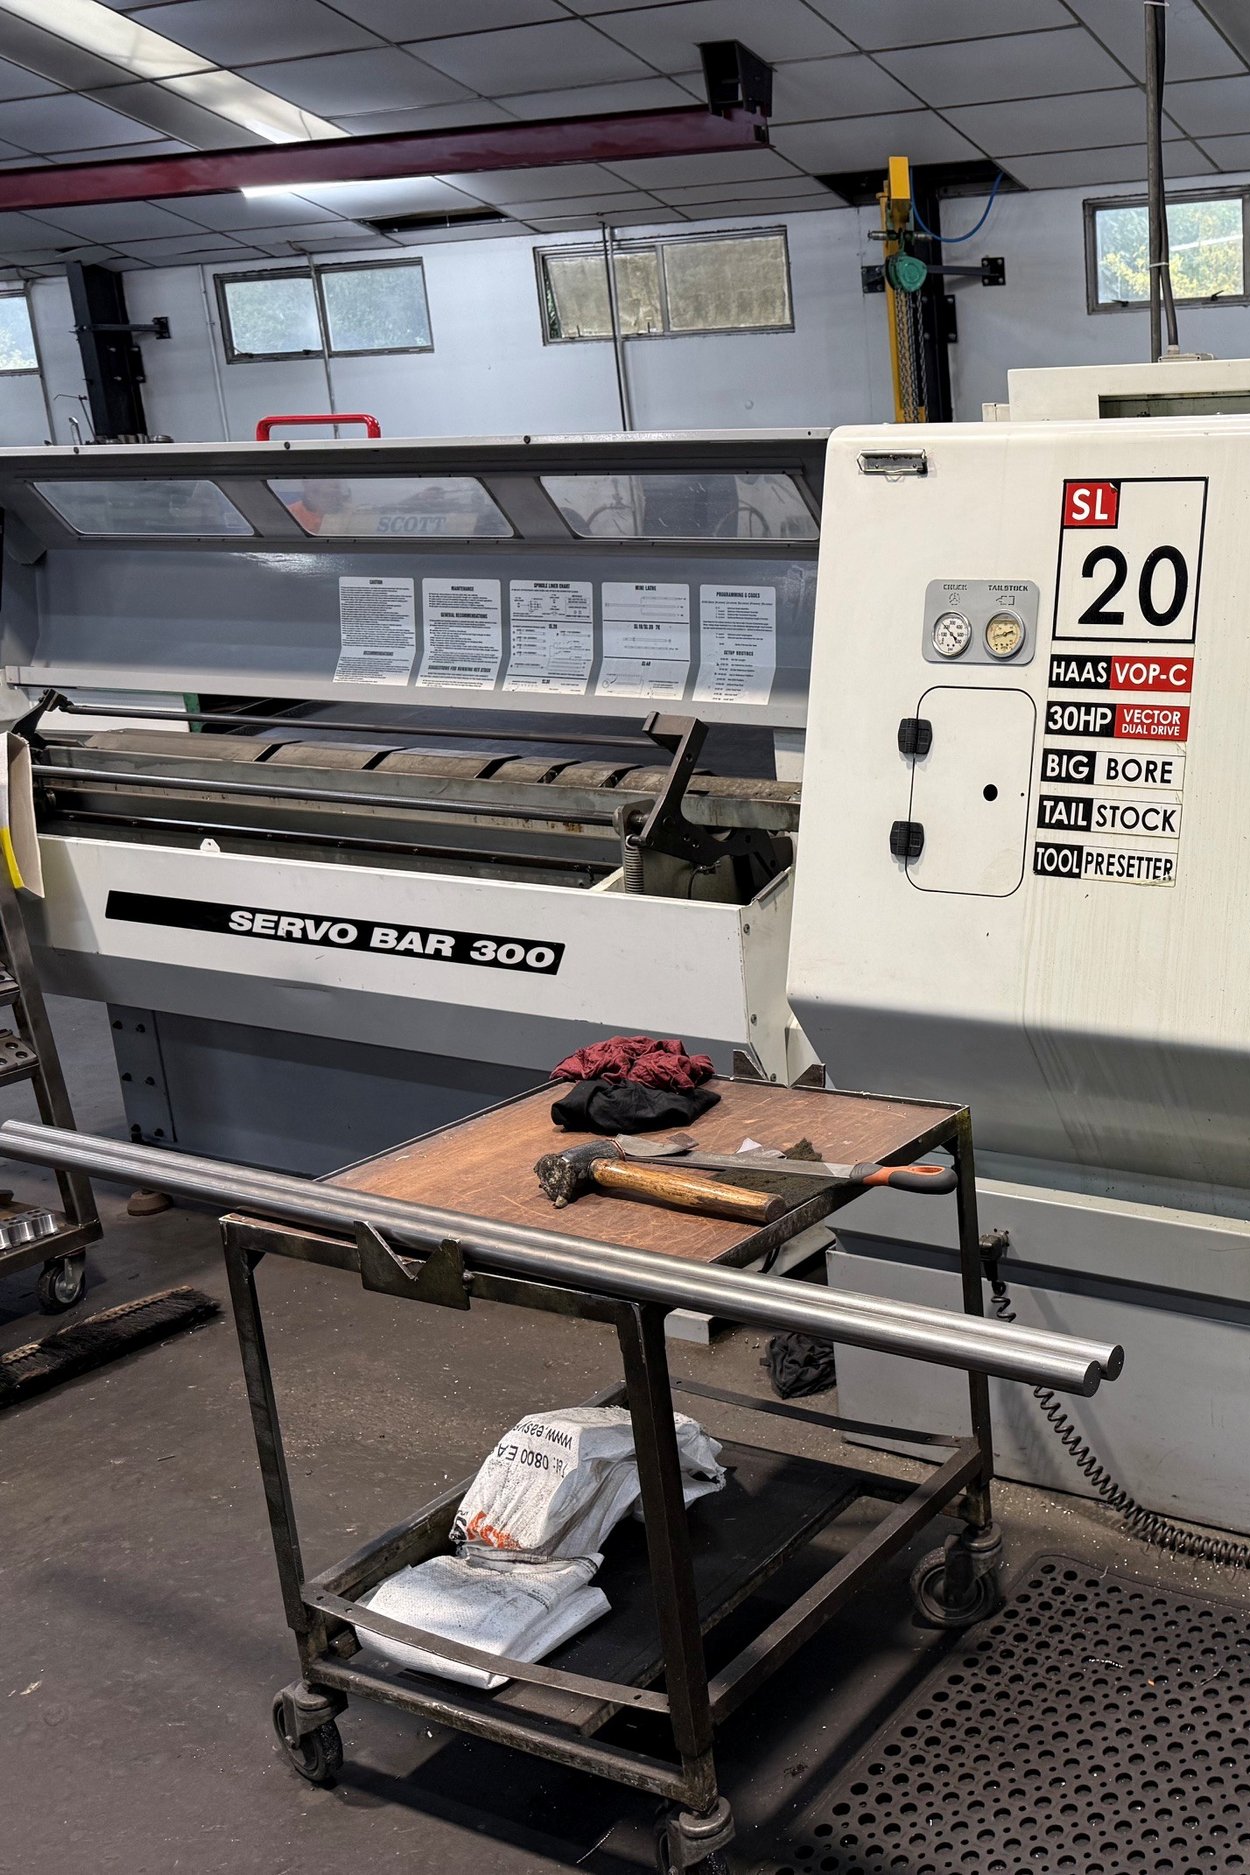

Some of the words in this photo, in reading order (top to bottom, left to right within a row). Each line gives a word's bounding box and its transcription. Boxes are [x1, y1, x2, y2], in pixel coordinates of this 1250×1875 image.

[1072, 488, 1108, 520] SL
[377, 515, 448, 533] SCOTT
[1078, 545, 1188, 627] 20
[1051, 661, 1108, 683] HAAS
[1114, 662, 1188, 686] VOP-C
[1048, 705, 1112, 732] 30HP
[1122, 724, 1148, 735] DUAL
[1151, 725, 1180, 736] DRIVE
[1123, 709, 1181, 725] VECTOR
[1046, 754, 1089, 780] BIG
[1106, 757, 1173, 784] BORE
[1043, 800, 1087, 826] TAIL
[1095, 804, 1176, 832] STOCK
[1036, 847, 1080, 873] TOOL
[1084, 852, 1173, 881] PRESETTER
[228, 910, 358, 944] SERVO
[369, 927, 456, 957] BAR
[470, 940, 556, 968] 300
[521, 1449, 548, 1470] 0800
